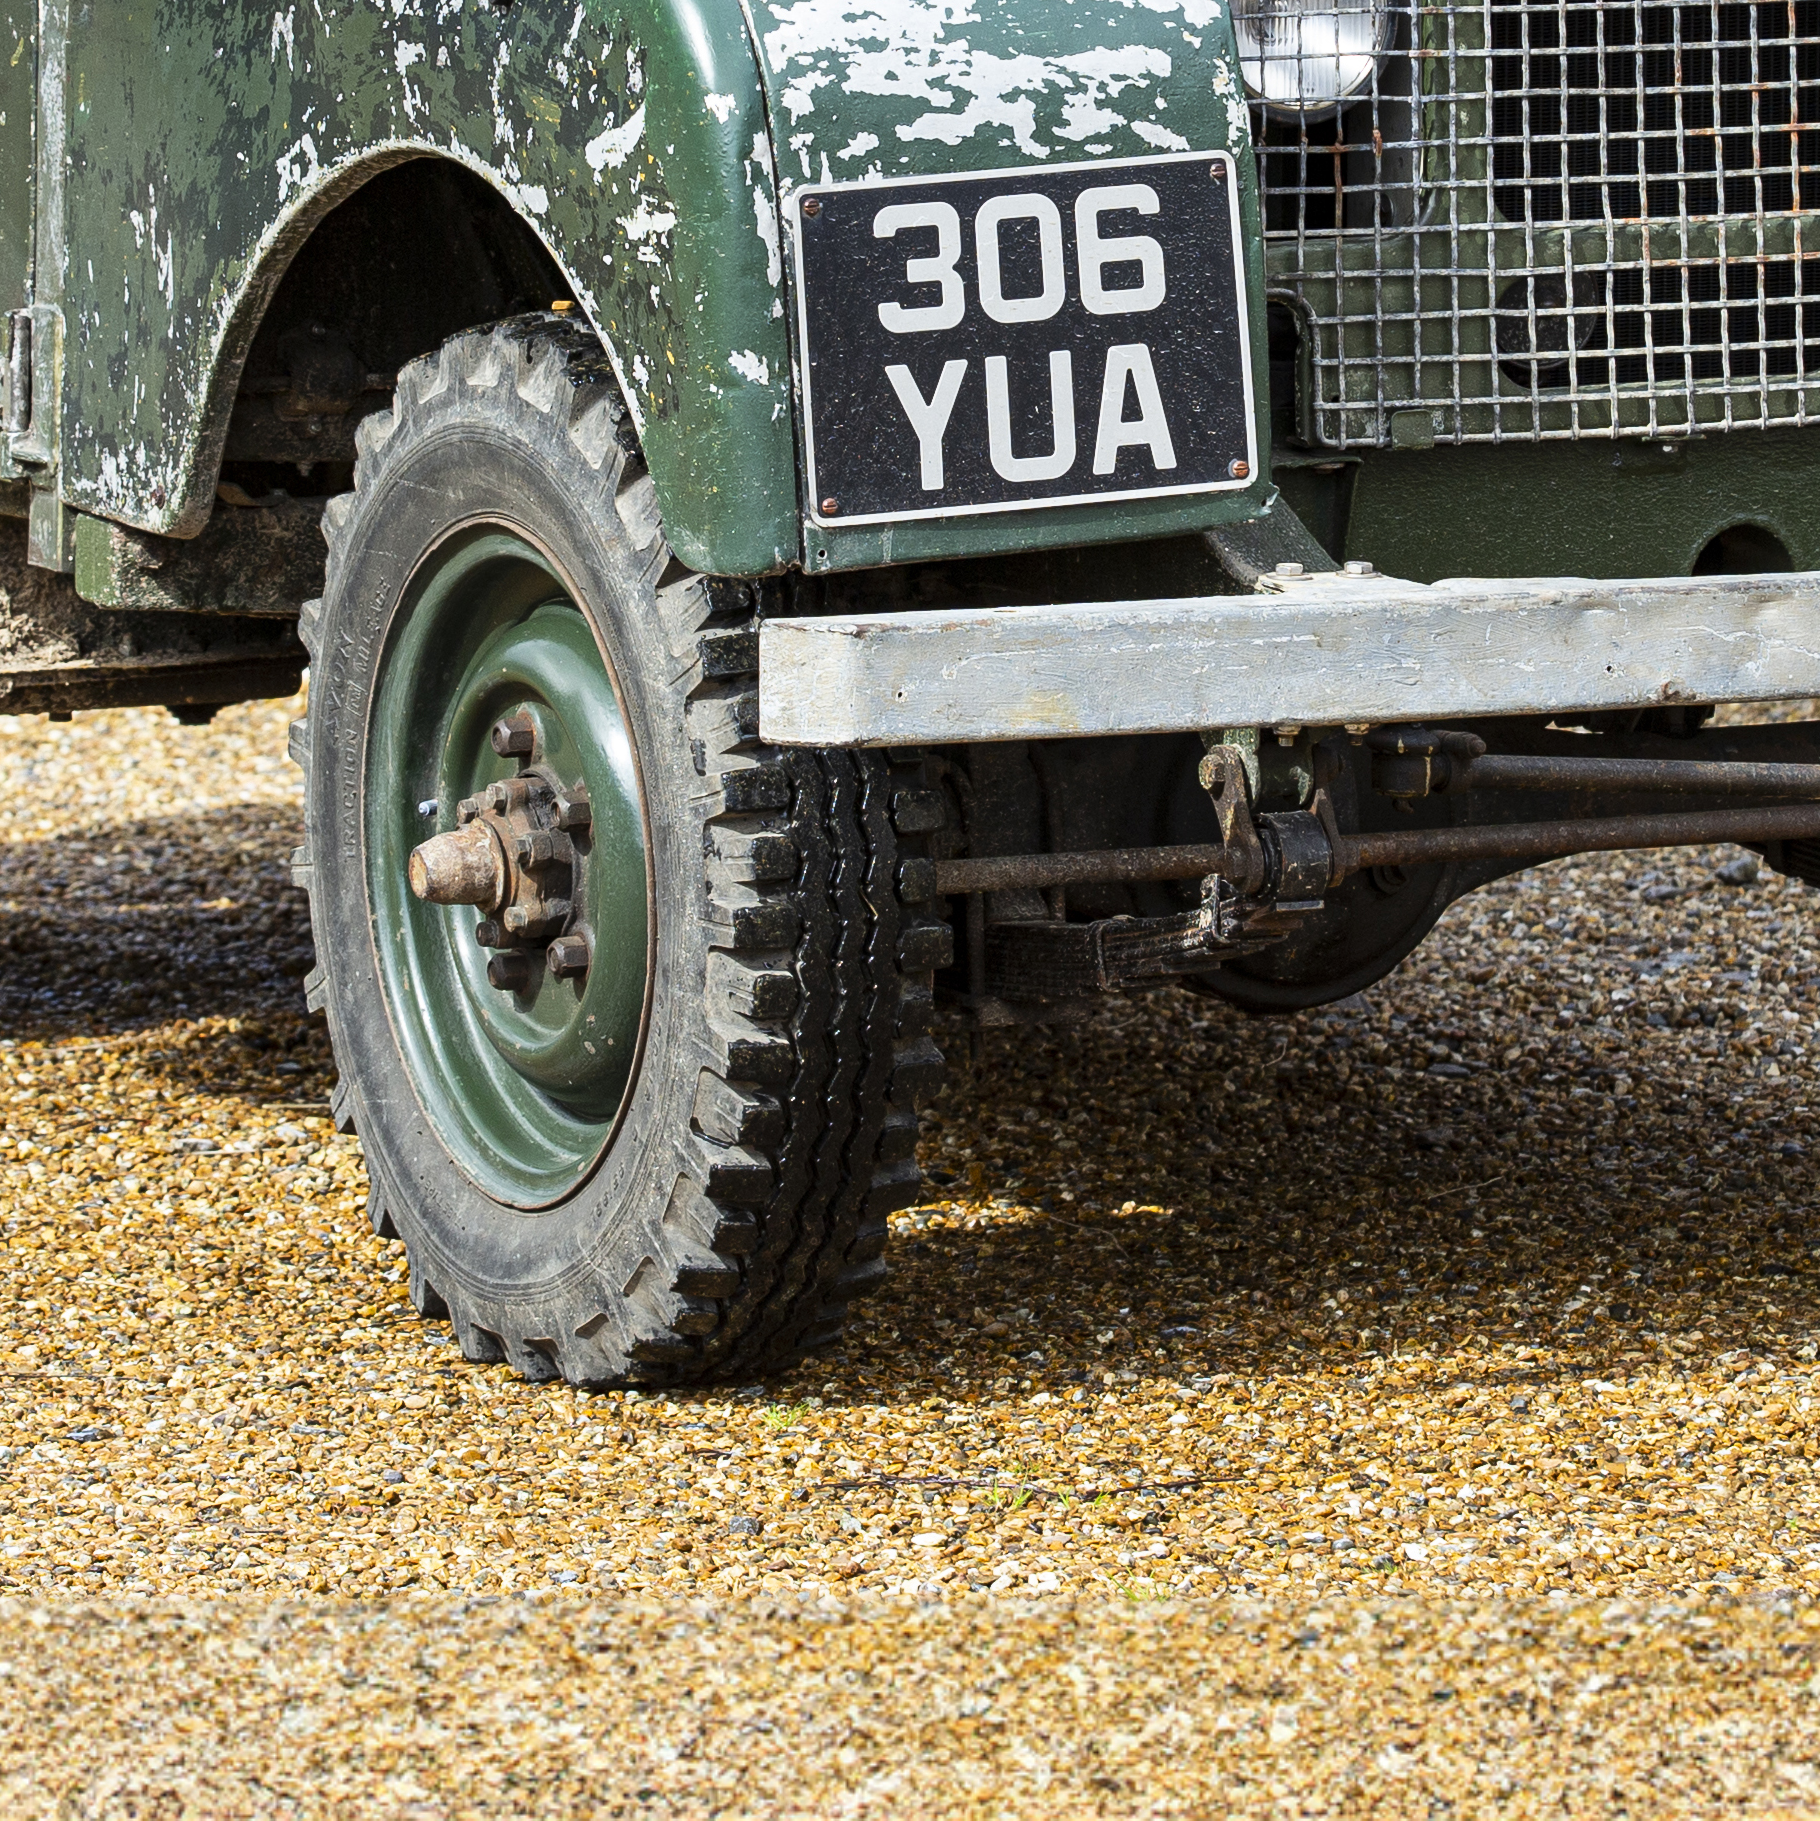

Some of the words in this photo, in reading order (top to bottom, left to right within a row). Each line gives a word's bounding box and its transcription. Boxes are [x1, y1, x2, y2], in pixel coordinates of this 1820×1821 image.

[873, 183, 1167, 334] 306
[884, 343, 1178, 492] YUA
[342, 728, 358, 861] TRACTION
